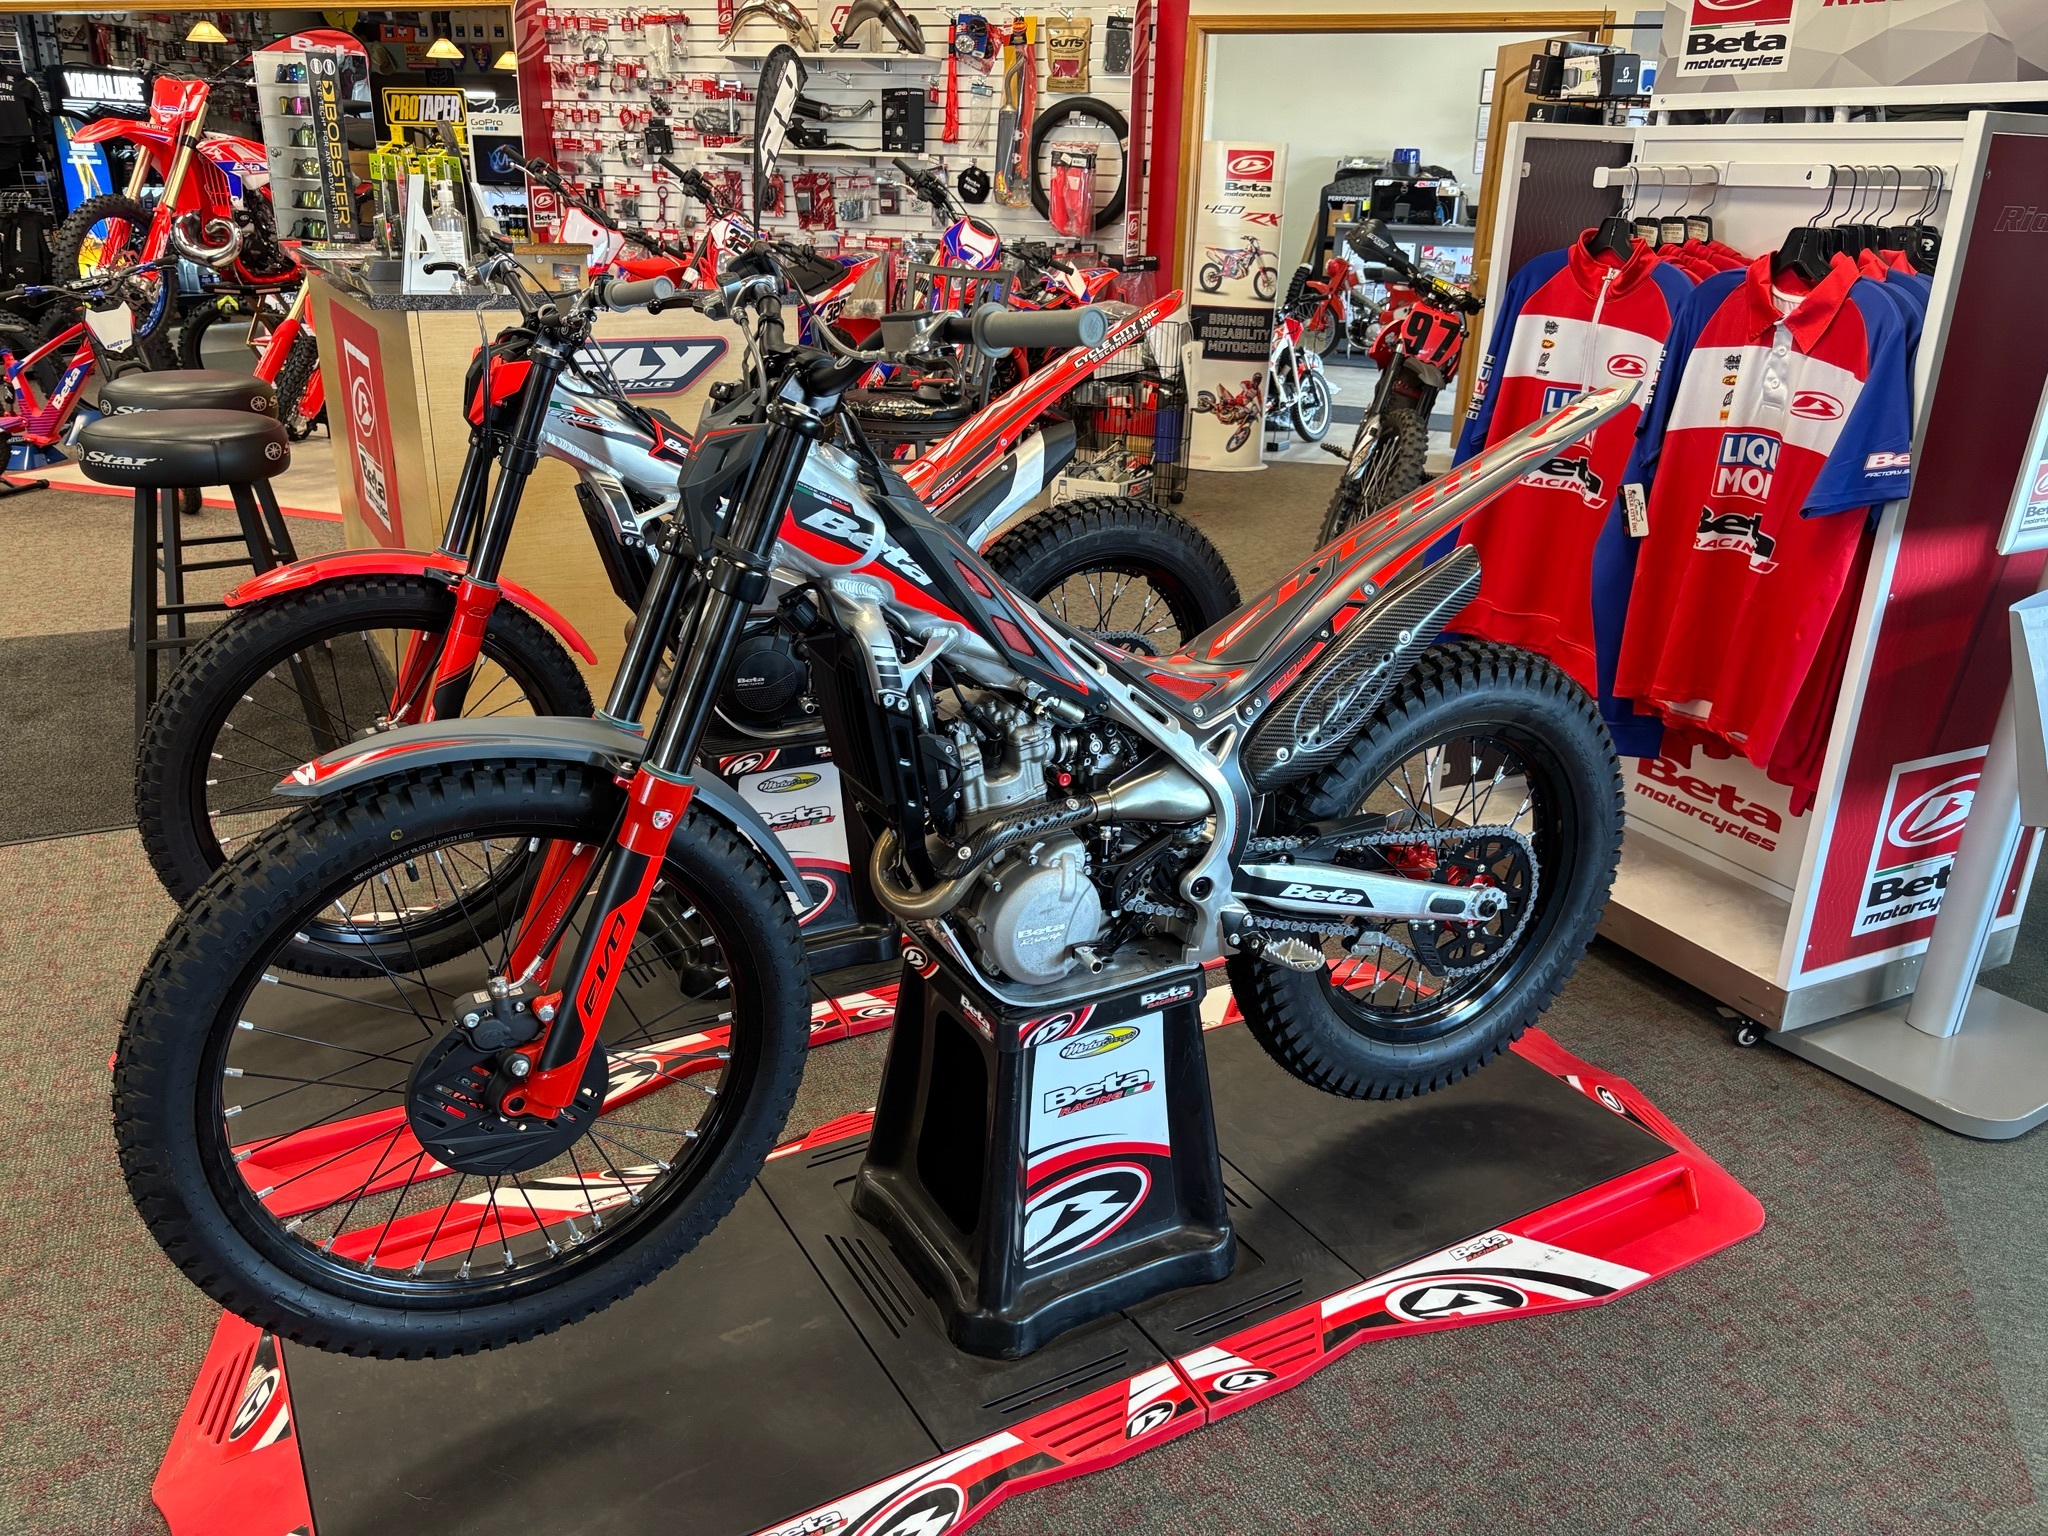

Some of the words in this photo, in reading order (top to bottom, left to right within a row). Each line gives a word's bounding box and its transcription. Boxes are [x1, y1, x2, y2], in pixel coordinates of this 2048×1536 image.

[1686, 30, 1787, 56] Beta
[1684, 55, 1783, 72] motorcycles
[63, 72, 144, 101] YAMALUBE
[470, 118, 504, 127] GoPro
[232, 161, 263, 172] Beta
[324, 103, 352, 225] BOBSTER
[1225, 182, 1271, 192] Beta
[1204, 204, 1246, 215] 450
[1201, 326, 1270, 340] RIDEABILITY
[1209, 313, 1265, 328] BRINGING
[1406, 302, 1461, 364] 97
[1074, 340, 1110, 369] CYCLE
[1113, 322, 1139, 344] CITY
[1139, 308, 1160, 324] INC
[52, 368, 81, 410] Beta
[86, 451, 158, 467] Star
[664, 438, 690, 456] Be
[1864, 452, 1911, 471] Be
[1538, 456, 1602, 495] eta
[932, 476, 957, 501] 200
[801, 507, 933, 586] Beta
[737, 676, 765, 685] Beta
[1637, 755, 1782, 834] Beta
[1635, 782, 1777, 852] motorcycles
[1279, 883, 1365, 905] Beta
[1866, 862, 1953, 908] Bet
[1018, 924, 1065, 939] Beta
[1140, 984, 1192, 1007] Beta
[961, 993, 991, 1030] Beta
[1044, 1069, 1150, 1114] Beta
[1057, 1091, 1124, 1118] RACING
[1449, 1234, 1508, 1261] Beta
